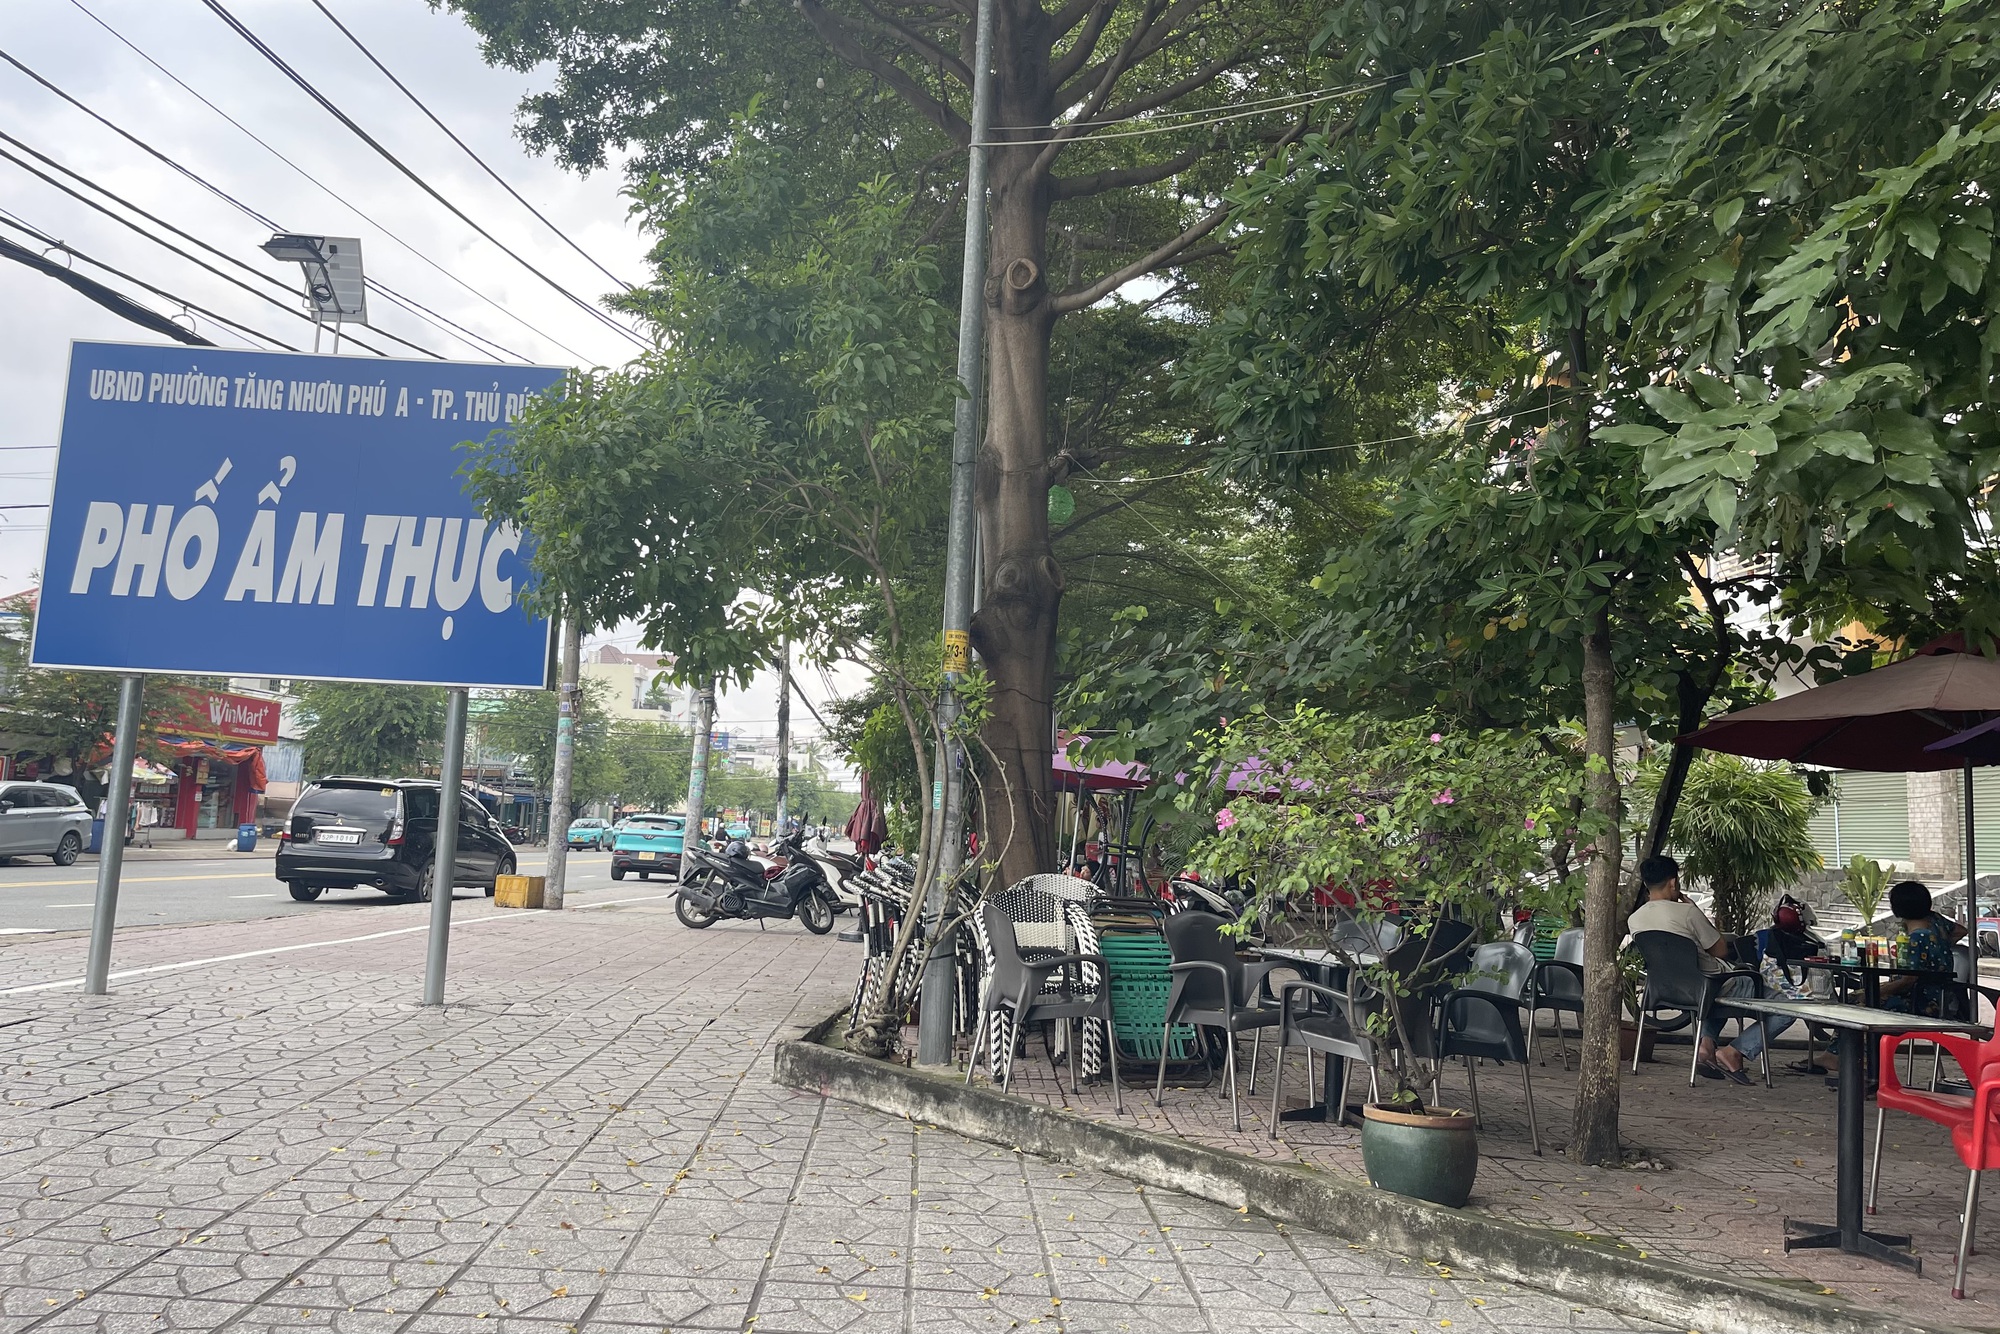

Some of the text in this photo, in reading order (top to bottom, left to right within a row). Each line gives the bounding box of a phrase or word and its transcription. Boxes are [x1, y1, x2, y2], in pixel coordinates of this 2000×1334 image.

[90, 369, 143, 402] UBND
[149, 365, 228, 408] PHƯỜNG
[235, 371, 283, 411] TĂNG
[288, 379, 342, 414] NHƠN
[347, 380, 387, 417] PHÚ
[395, 387, 408, 418] A
[431, 389, 458, 421] TP.
[466, 381, 501, 423] THỦ
[70, 456, 524, 640] PHỐ ẨM THỤC
